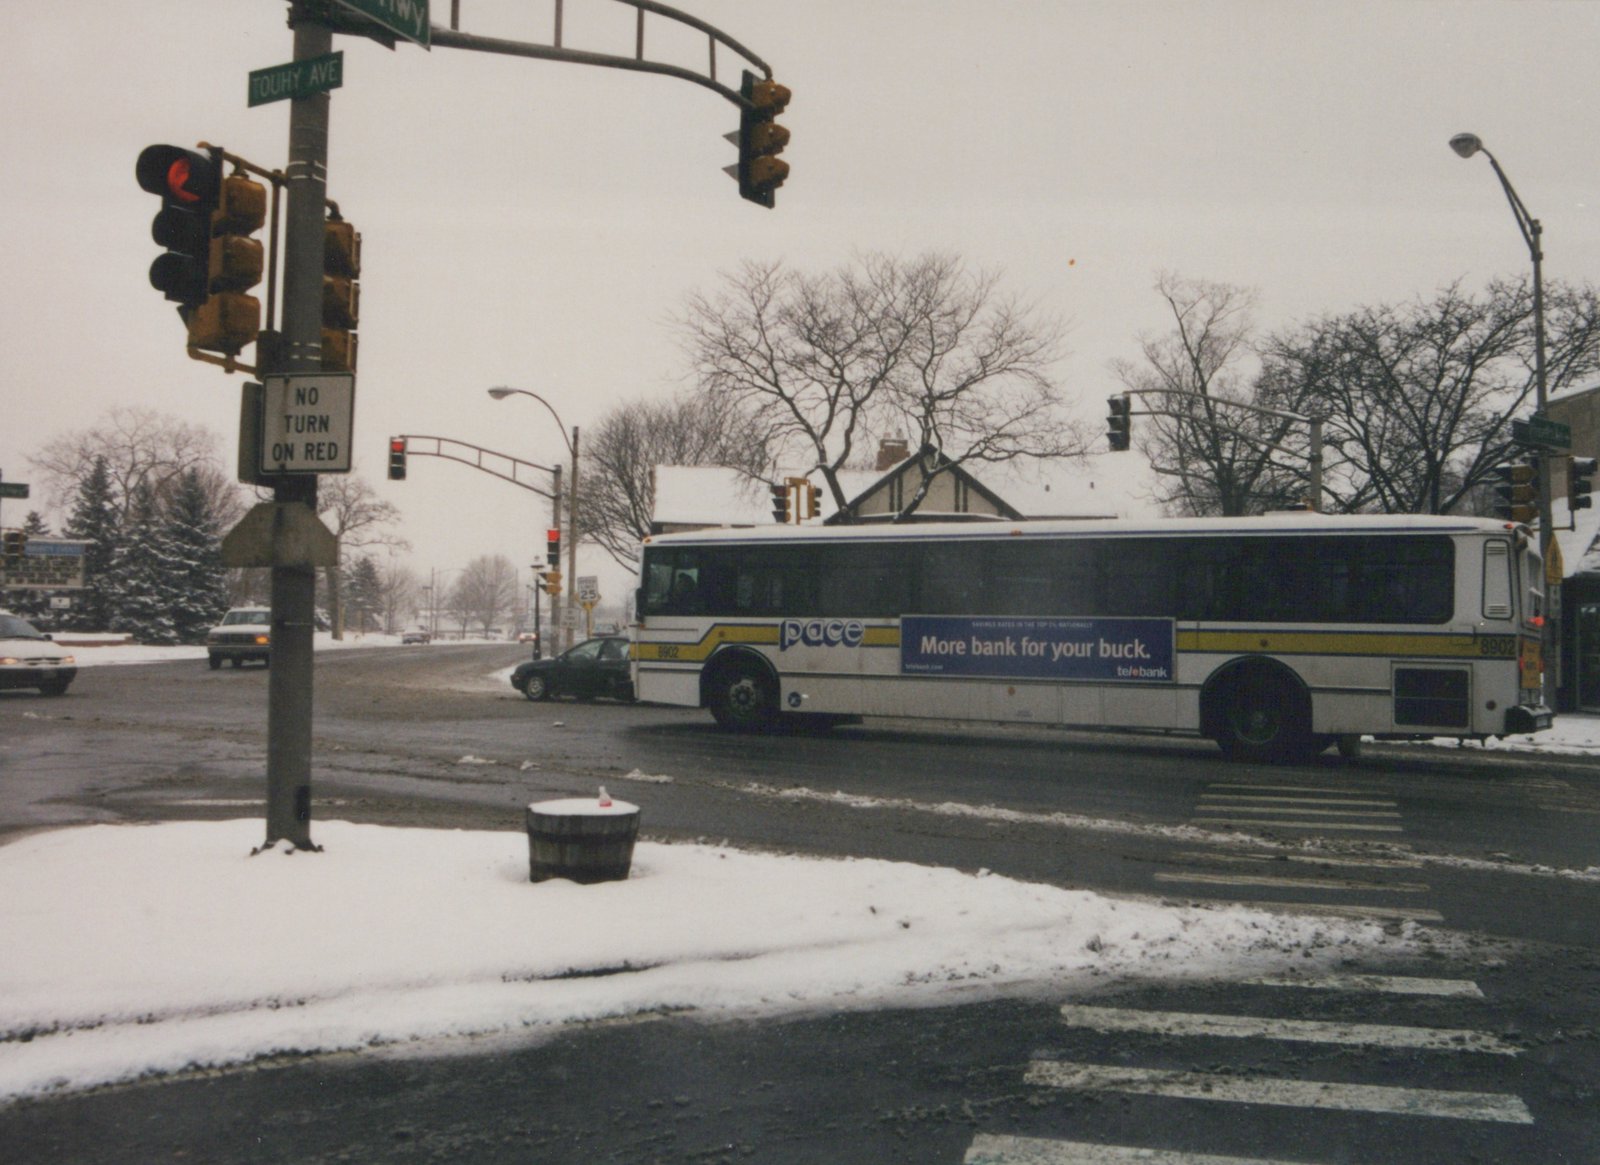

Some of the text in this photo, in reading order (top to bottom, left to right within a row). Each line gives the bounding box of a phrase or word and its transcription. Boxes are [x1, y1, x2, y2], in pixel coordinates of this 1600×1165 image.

[252, 60, 338, 98] TOUHY AVE
[296, 387, 318, 406] NO
[284, 415, 329, 433] TURN
[272, 442, 338, 461] ON RED
[581, 590, 597, 600] 25
[779, 619, 865, 651] pace
[658, 646, 679, 658] 8902
[920, 635, 1151, 662] More bank for your buck.
[1480, 638, 1516, 655] 8902
[1117, 665, 1168, 678] telebank
